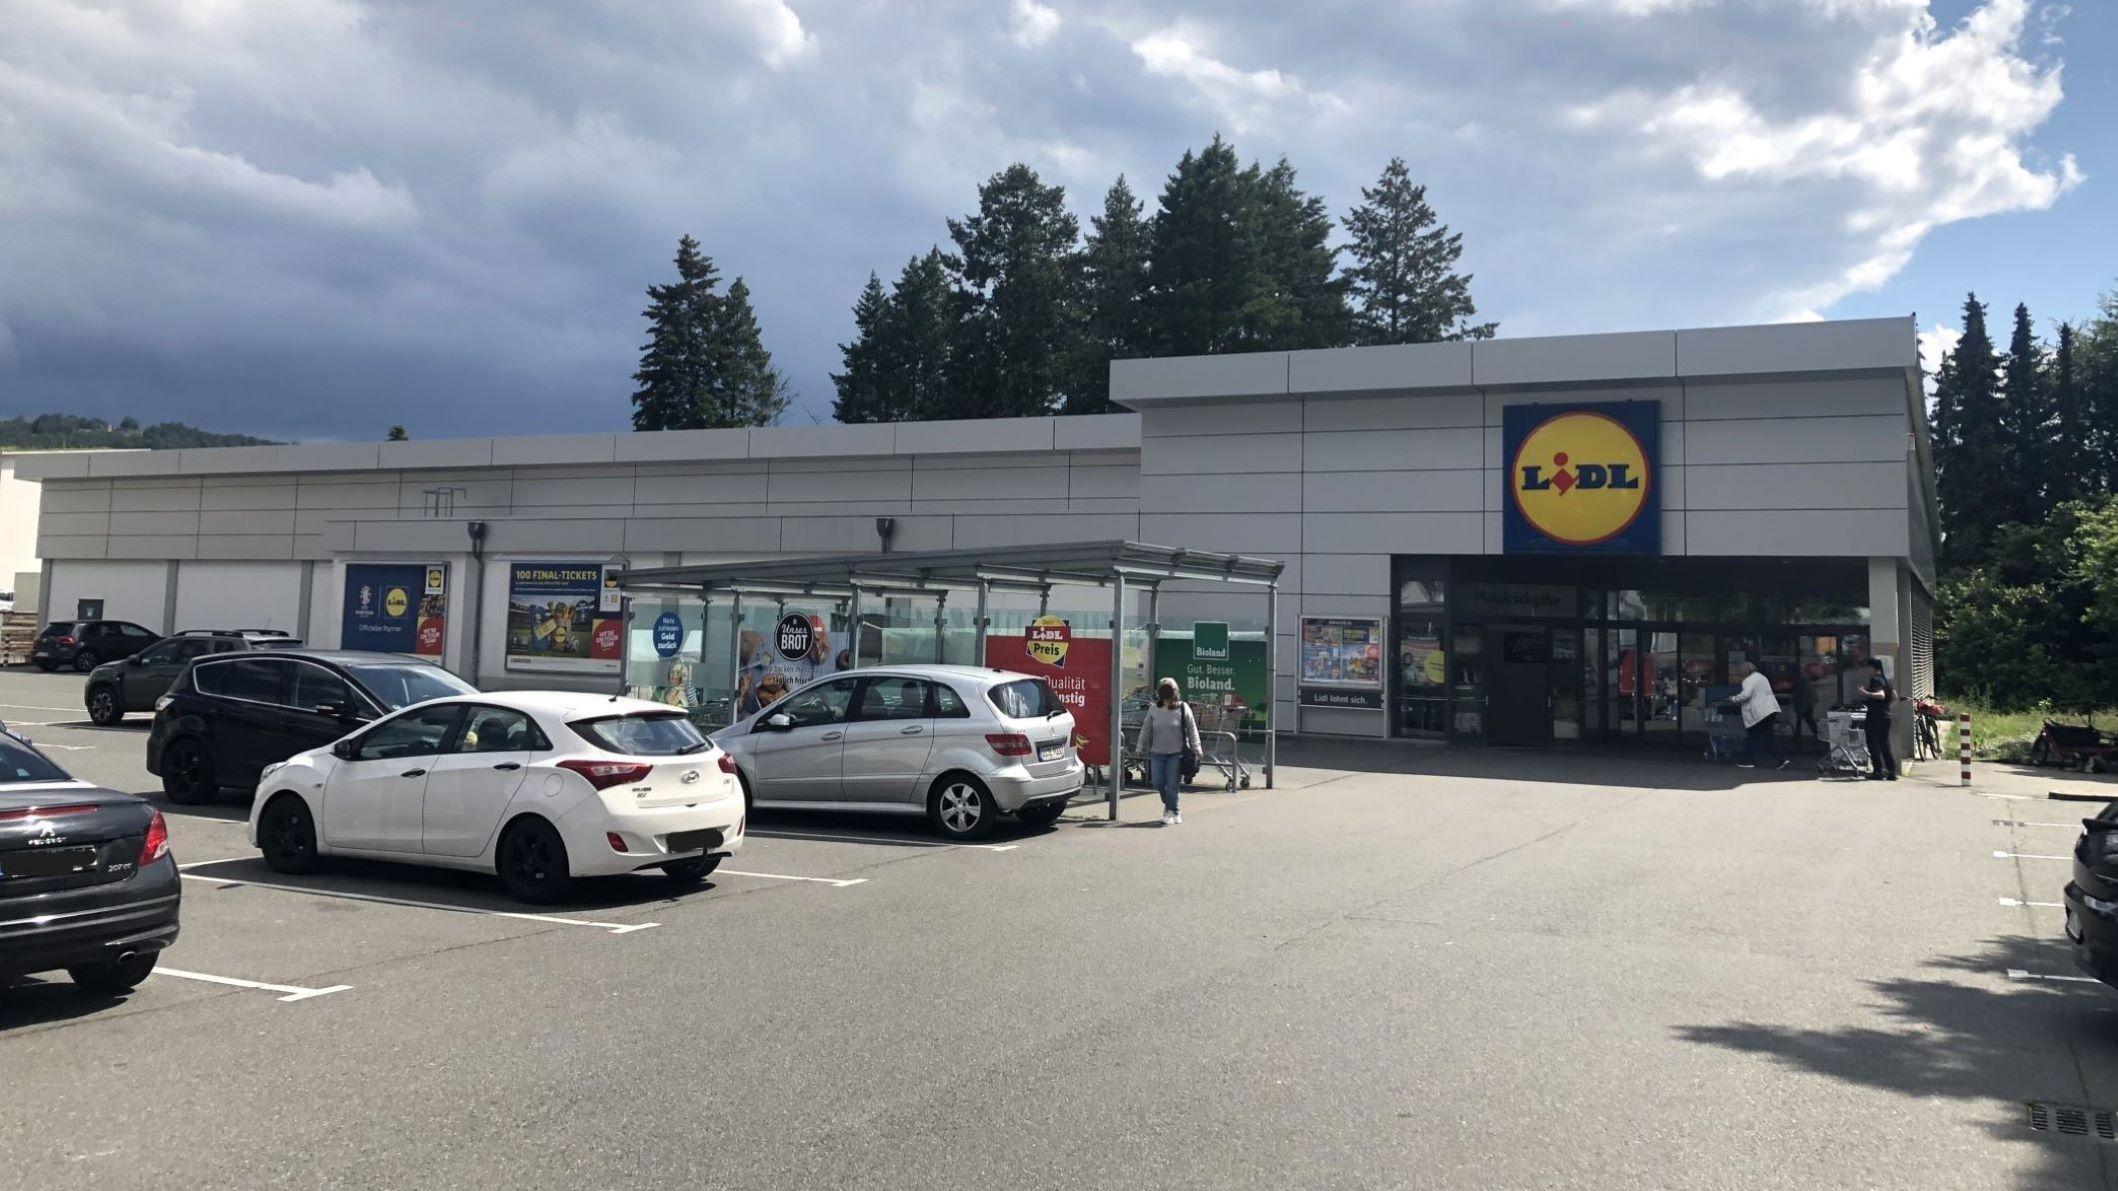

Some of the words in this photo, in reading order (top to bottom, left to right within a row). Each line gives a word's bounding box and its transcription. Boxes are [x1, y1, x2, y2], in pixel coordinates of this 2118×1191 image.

[516, 570, 531, 580] 100
[533, 570, 597, 580] FINAL-TICKETS
[782, 624, 807, 634] Unser
[658, 641, 677, 649] zurück
[781, 634, 808, 650] BROT
[1034, 643, 1060, 656] Preis
[1196, 647, 1226, 657] Bioland
[1187, 664, 1203, 674] Gut.
[1207, 664, 1236, 675] Besser.
[1187, 677, 1235, 690] Bioland.
[1314, 694, 1328, 702] Lidl
[1330, 694, 1349, 703] lohnt
